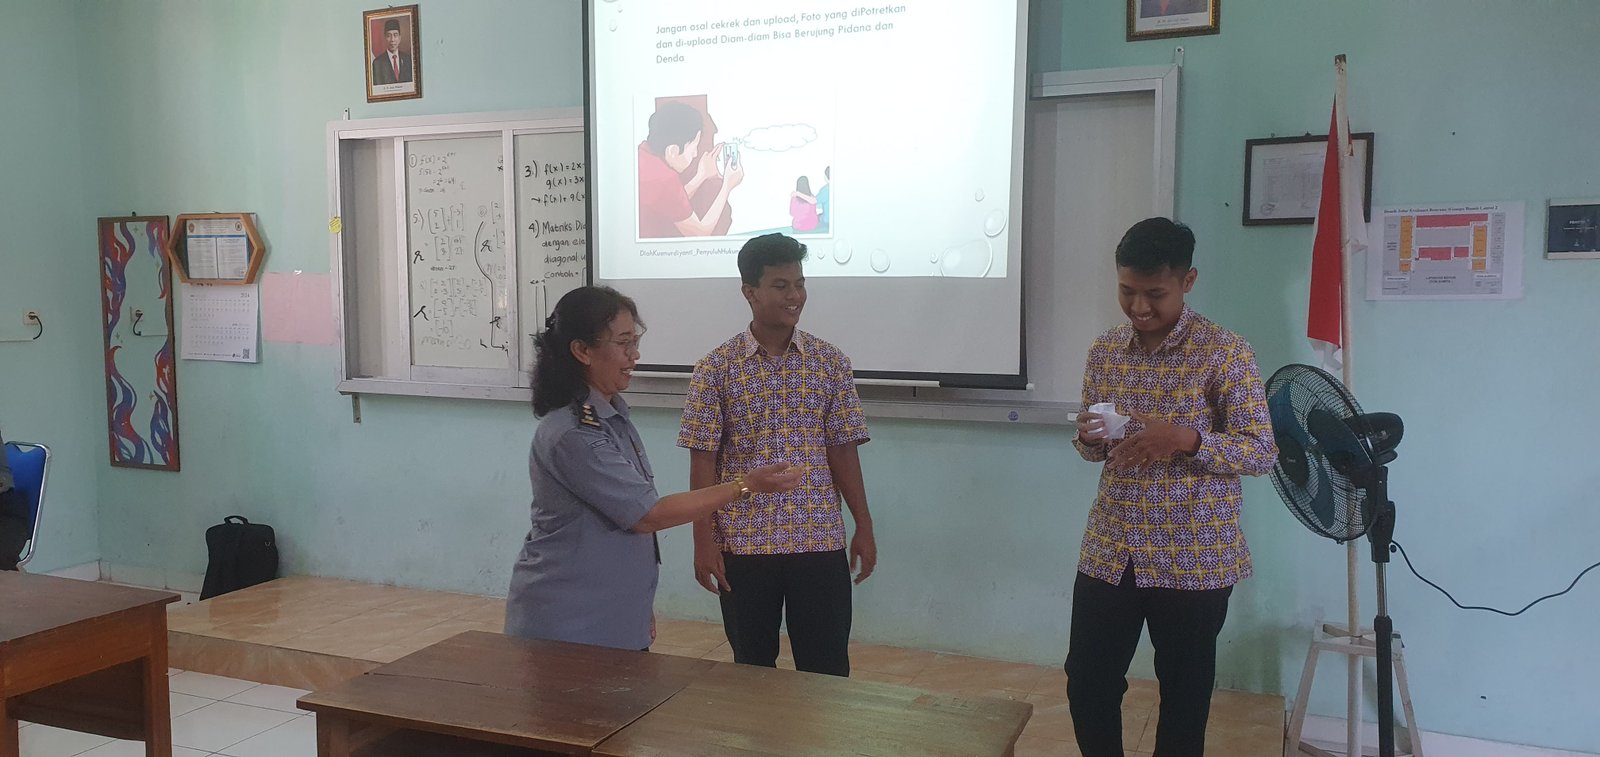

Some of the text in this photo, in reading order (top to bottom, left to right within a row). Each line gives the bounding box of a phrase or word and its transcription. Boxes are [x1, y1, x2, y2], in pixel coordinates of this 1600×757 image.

[656, 4, 906, 35] Jangan asal cekrek dan upload, Foto yang diPotretkan
[656, 21, 894, 49] dan di-upload Diam-diam Bisa Berujung Pidana dan
[656, 53, 685, 64] Denda
[542, 239, 570, 251] dengan
[544, 251, 578, 267] diagonal
